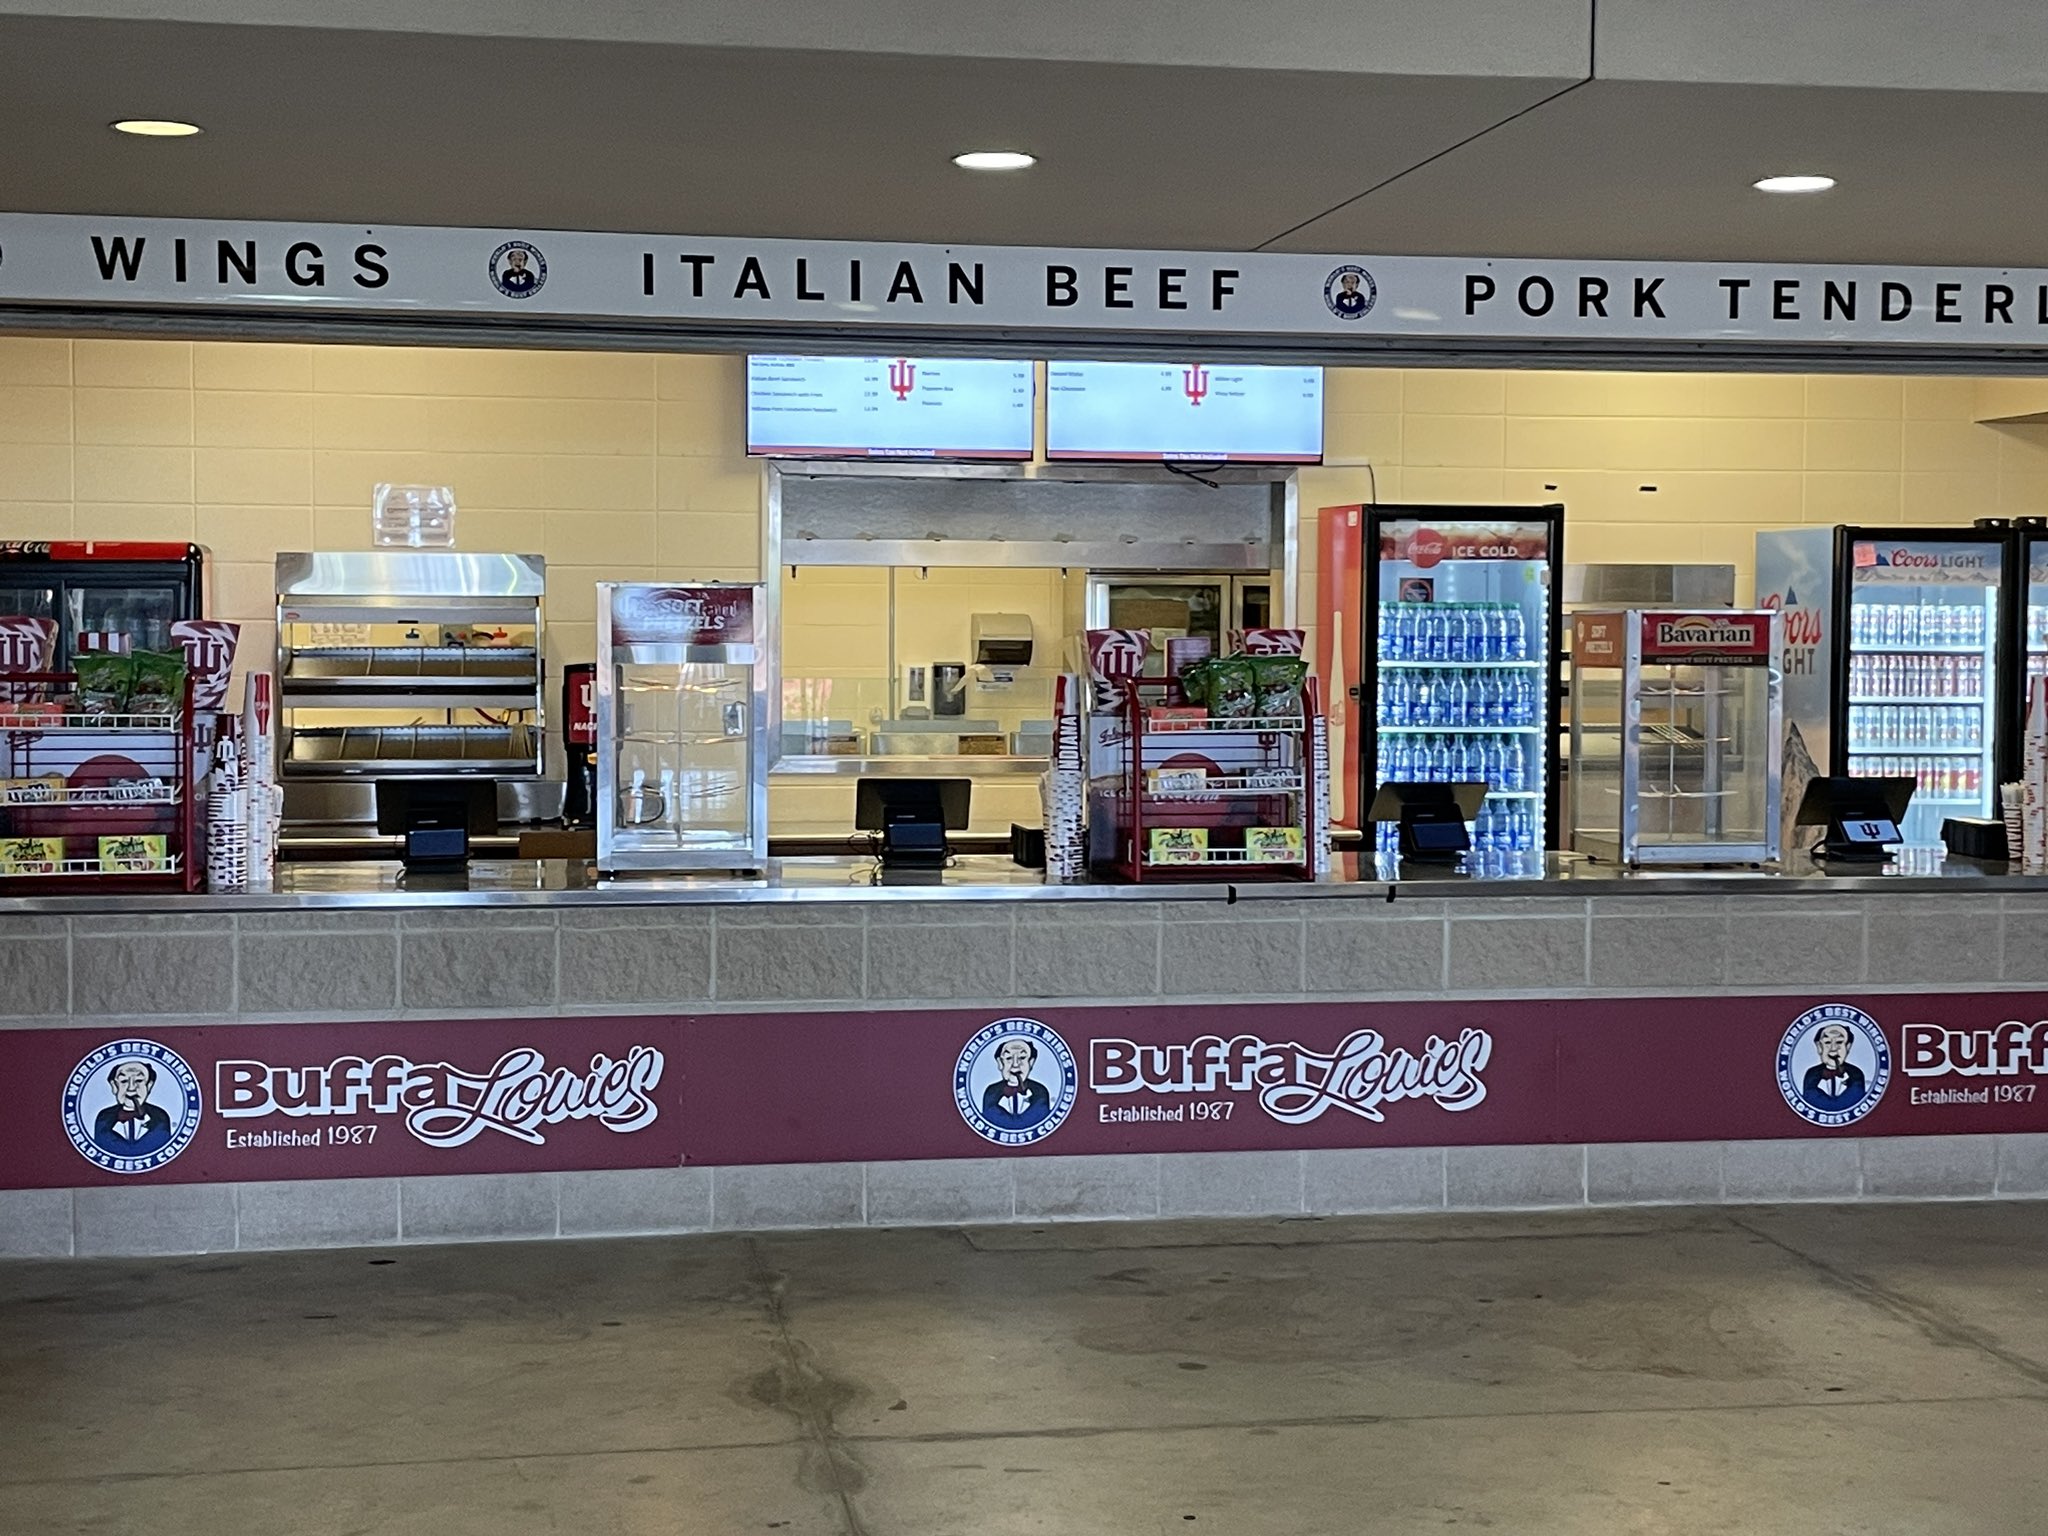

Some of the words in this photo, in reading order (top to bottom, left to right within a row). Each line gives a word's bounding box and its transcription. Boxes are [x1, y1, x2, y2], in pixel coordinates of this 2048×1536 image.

[91, 236, 388, 289] WINGS
[643, 253, 984, 305] ITALIAN
[1046, 265, 1239, 311] BEEF
[1466, 274, 1666, 319] PORK
[1452, 546, 1476, 557] ICE
[1479, 545, 1519, 558] COLD
[1891, 548, 1939, 568] Coors
[1940, 555, 1985, 568] LIGHT
[1660, 624, 1752, 643] Bavarian
[958, 1024, 1003, 1072] WORLD'S
[1006, 1021, 1041, 1033] BEST
[1042, 1029, 1072, 1068] WINGS
[1781, 1010, 1822, 1055] WORLD'S
[1825, 1007, 1857, 1019] BEST
[1858, 1016, 1886, 1052] WINGS
[67, 1045, 117, 1096] WORLD'S
[120, 1043, 160, 1056] BEST
[161, 1051, 196, 1091] WINGS
[957, 1087, 996, 1138] WORLD'S
[999, 1131, 1033, 1143] BEST
[1037, 1085, 1074, 1135] COLLEGE
[1099, 1104, 1184, 1123] Established
[1189, 1101, 1234, 1121] 1987
[1779, 1070, 1816, 1119] WORLD'S
[1819, 1112, 1850, 1124] BEST
[1853, 1068, 1888, 1117] COLLEGE
[1910, 1087, 1989, 1104] Established
[1994, 1085, 2036, 1103] 1987
[66, 1111, 110, 1165] WORLD'S
[114, 1158, 151, 1170] BEST
[156, 1109, 198, 1163] COLLEGE
[226, 1128, 321, 1149] Established
[328, 1125, 378, 1145] 1987
